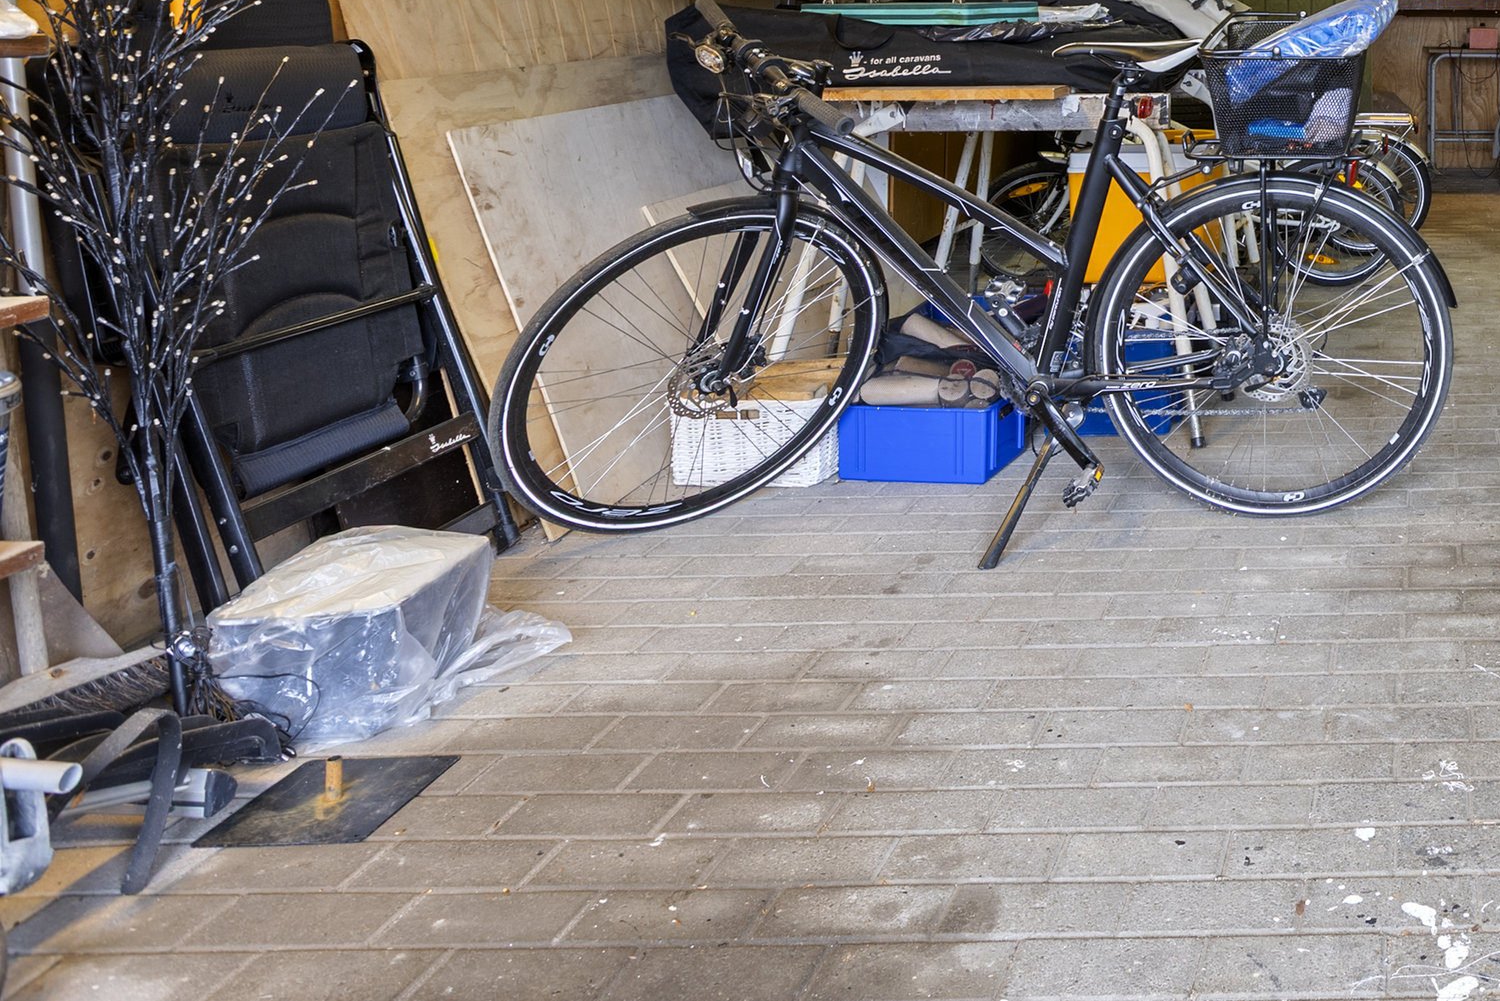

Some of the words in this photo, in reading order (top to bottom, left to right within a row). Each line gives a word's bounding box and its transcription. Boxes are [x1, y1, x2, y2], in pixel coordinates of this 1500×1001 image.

[870, 57, 884, 65] for
[885, 56, 897, 64] all
[899, 54, 941, 64] caravans
[842, 64, 952, 80] Isabella
[1120, 381, 1157, 389] zero
